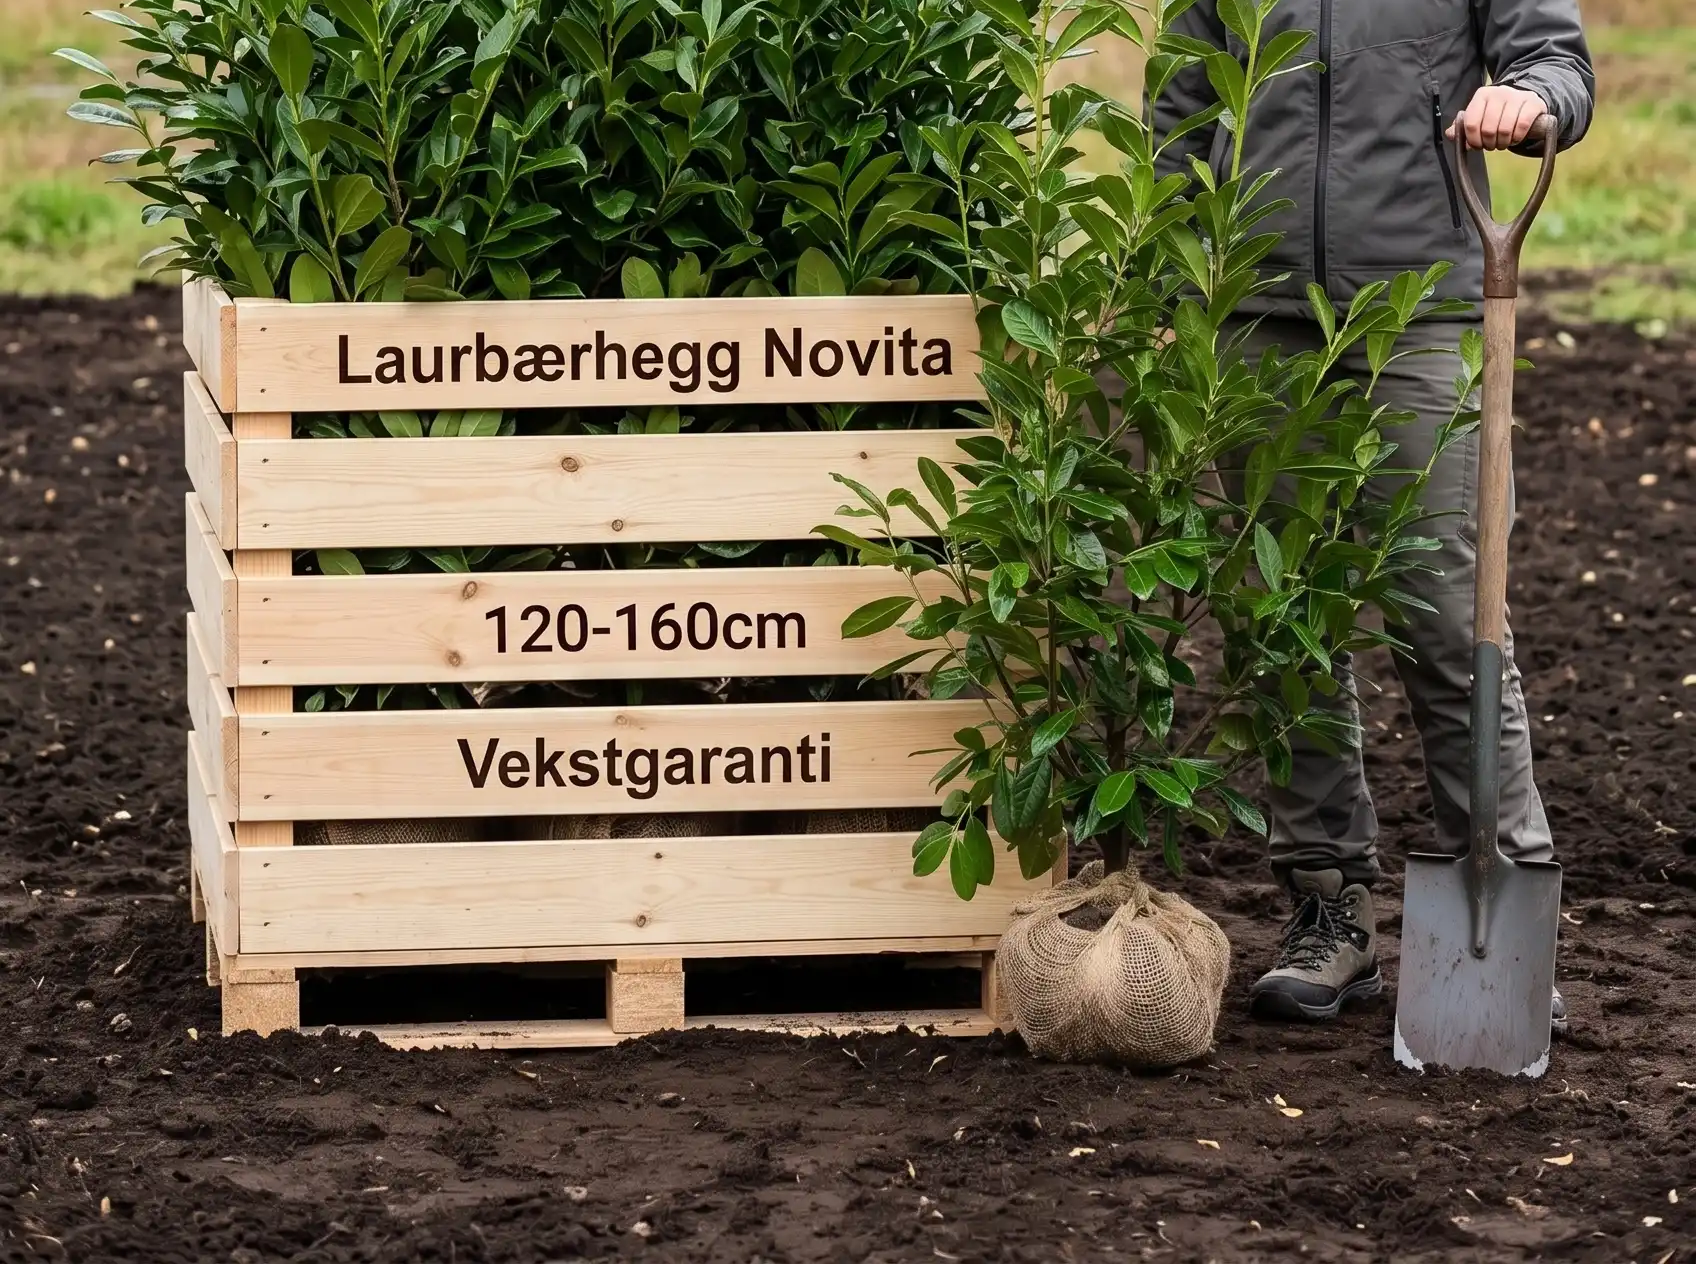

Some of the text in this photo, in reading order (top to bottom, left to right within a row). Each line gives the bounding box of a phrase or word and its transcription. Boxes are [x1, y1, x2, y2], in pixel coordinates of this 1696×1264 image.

[338, 325, 954, 394] Laurbærhegg Novita
[485, 601, 806, 654] 120-160cm
[456, 732, 831, 800] Vekstgaranti
